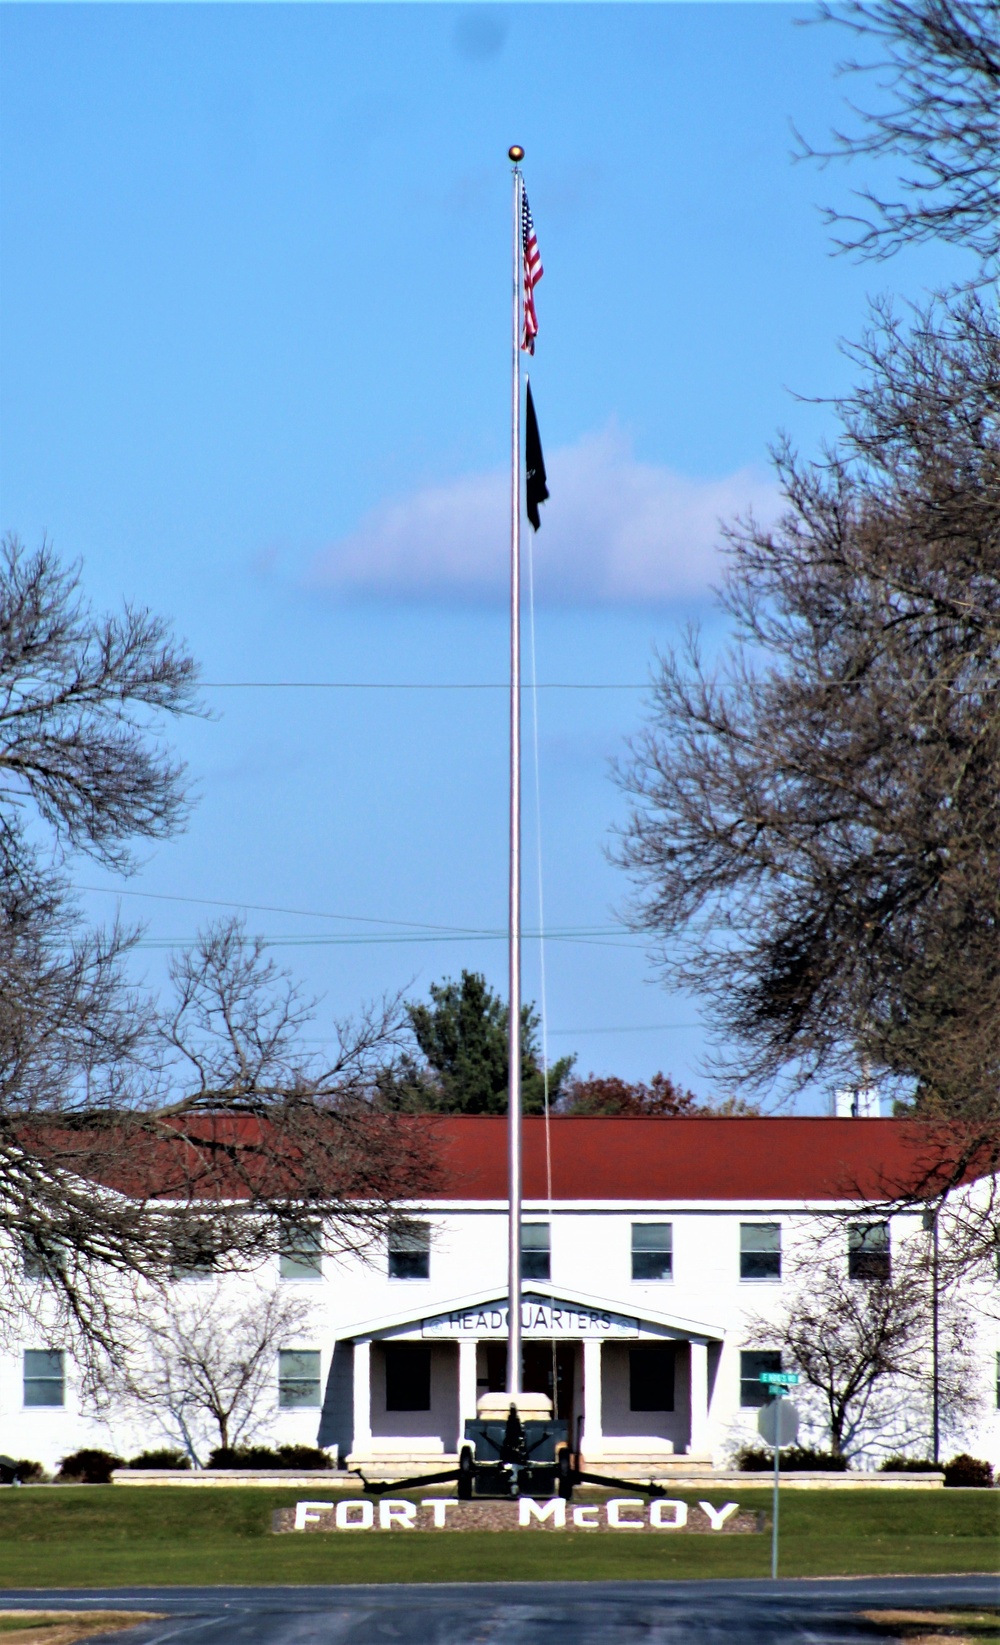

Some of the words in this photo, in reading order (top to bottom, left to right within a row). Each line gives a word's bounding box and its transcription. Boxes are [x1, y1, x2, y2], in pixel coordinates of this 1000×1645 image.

[448, 1307, 612, 1331] HEADUARTERS
[293, 1498, 459, 1530] FORT
[518, 1498, 740, 1531] McCOY
